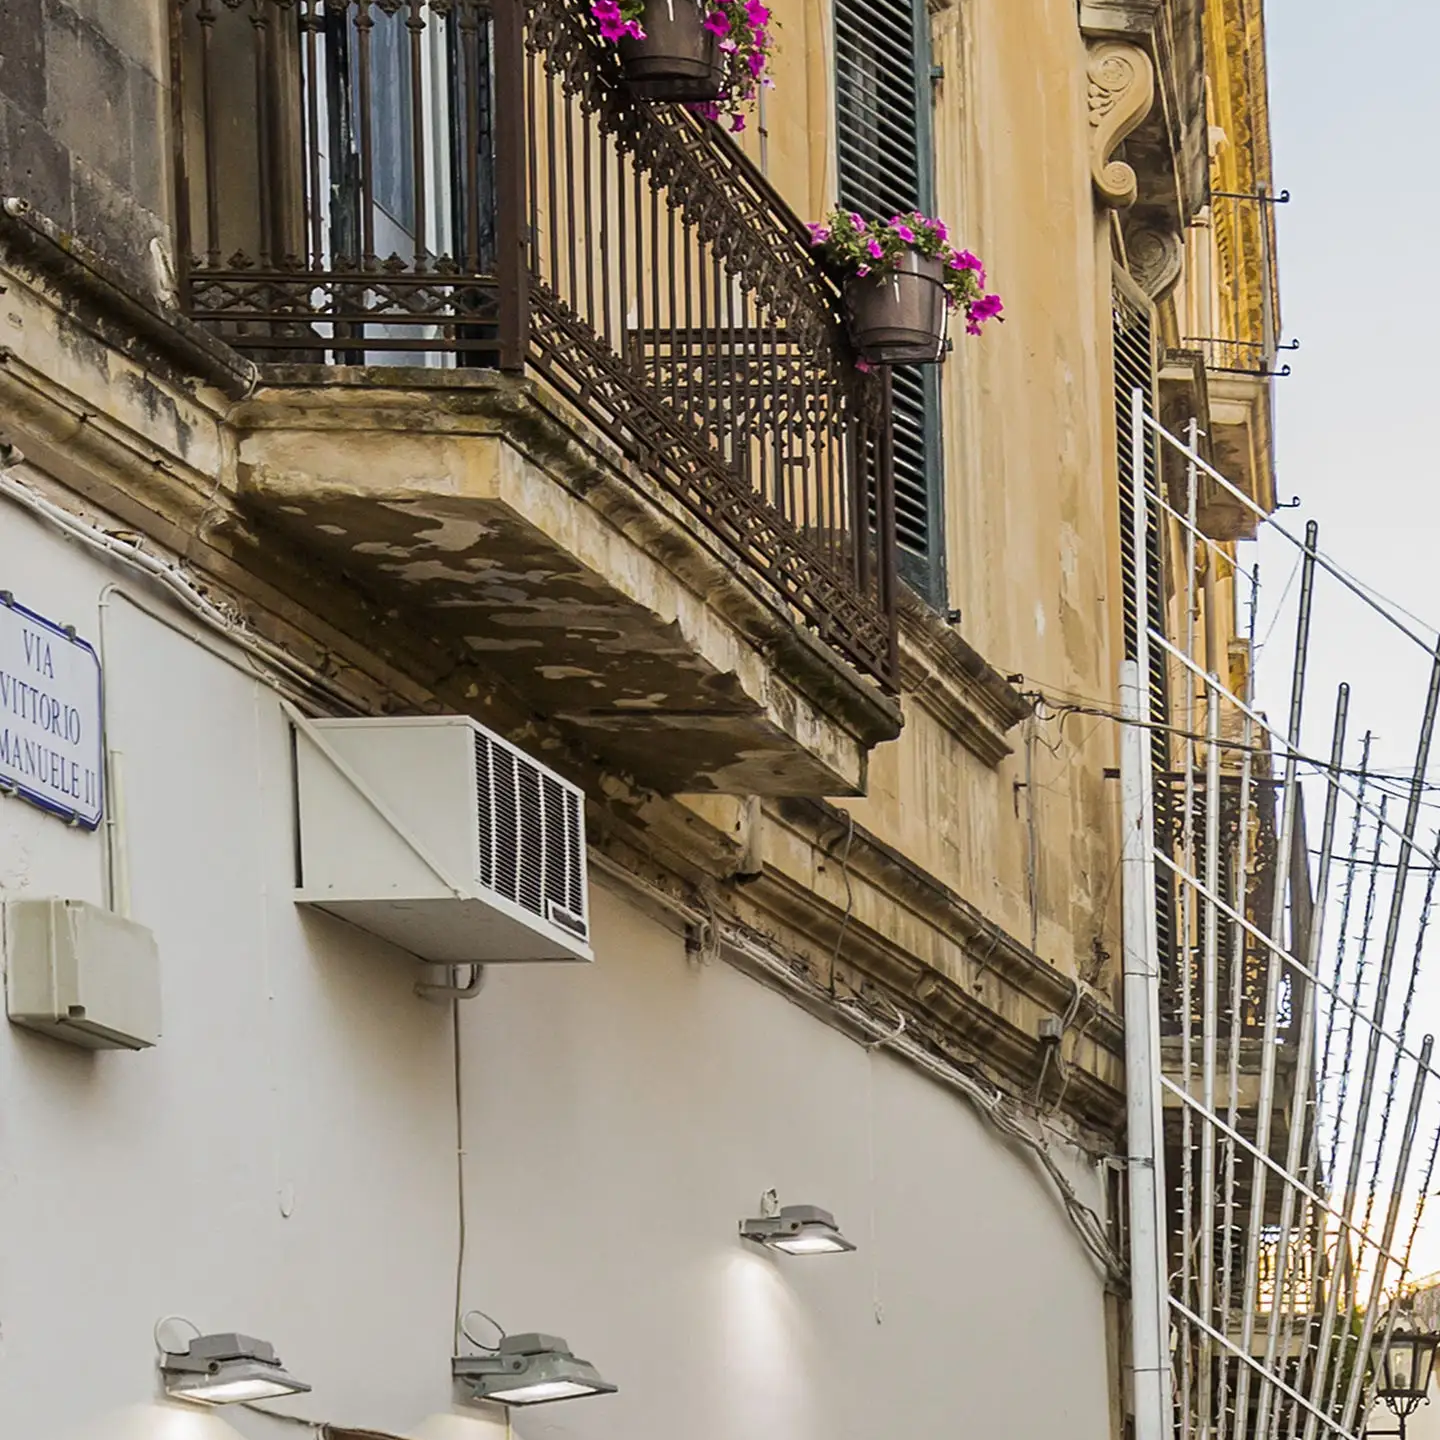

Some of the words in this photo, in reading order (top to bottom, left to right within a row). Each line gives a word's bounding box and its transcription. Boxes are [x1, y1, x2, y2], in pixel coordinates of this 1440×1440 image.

[22, 629, 54, 679] VIA
[0, 671, 81, 746] VITTORIO
[85, 768, 96, 807] II
